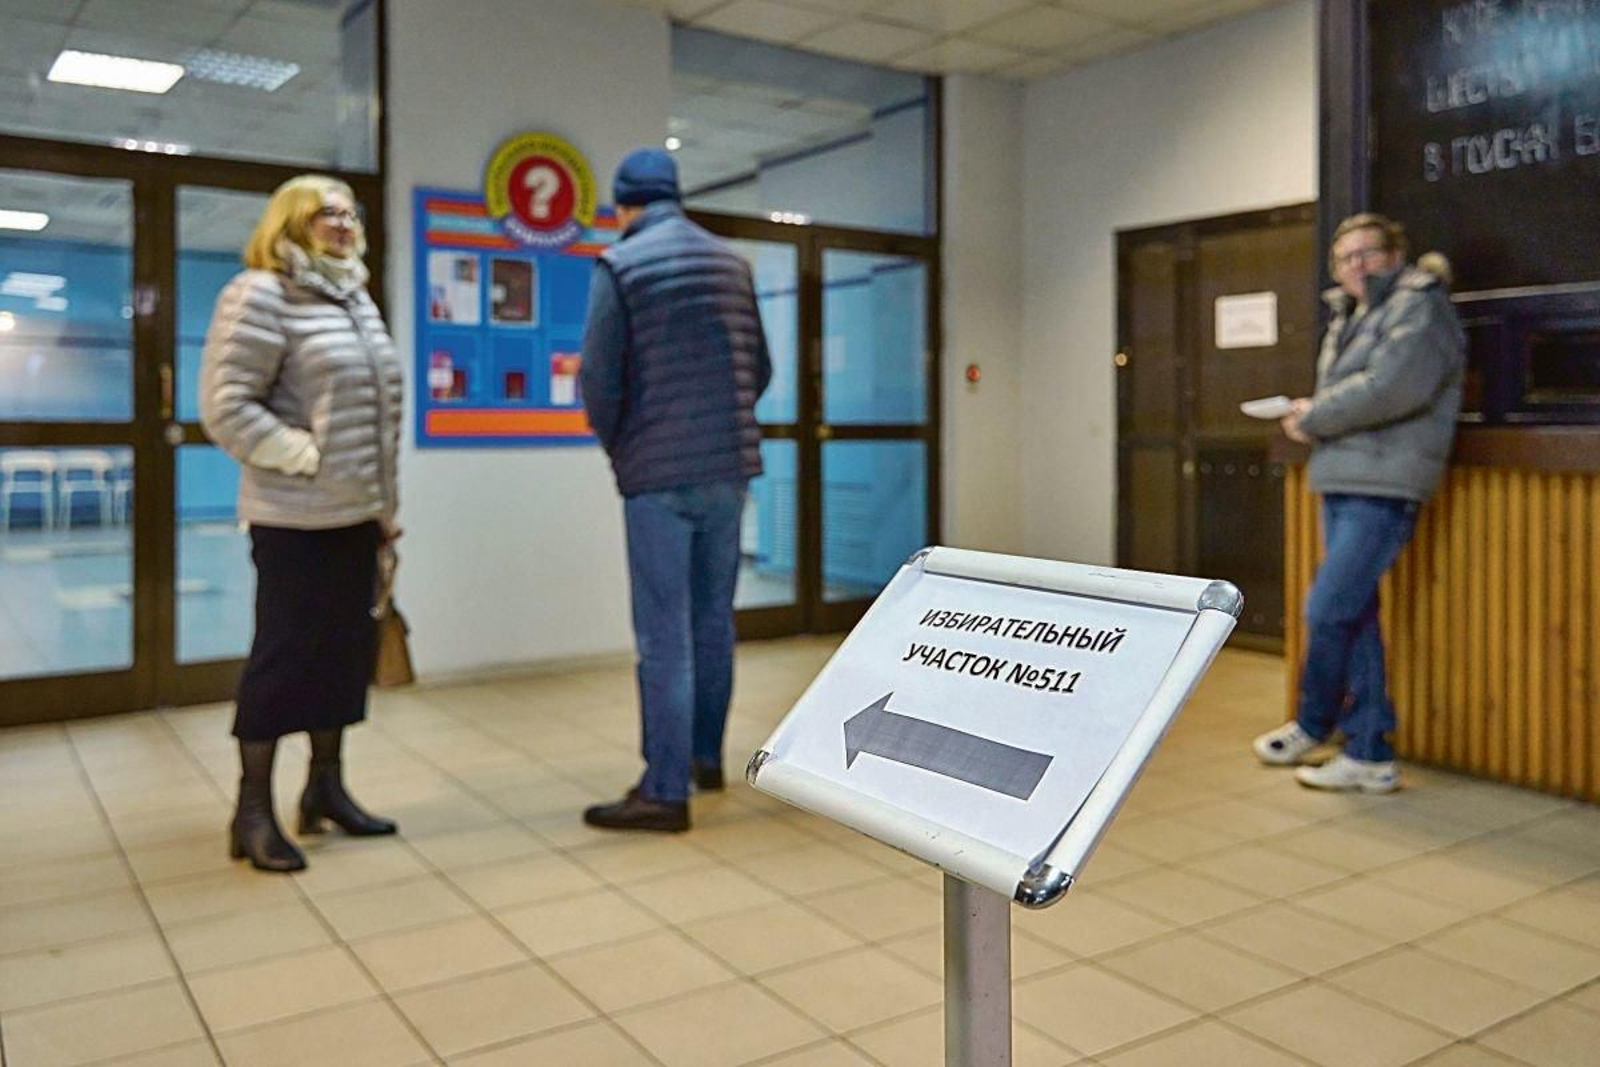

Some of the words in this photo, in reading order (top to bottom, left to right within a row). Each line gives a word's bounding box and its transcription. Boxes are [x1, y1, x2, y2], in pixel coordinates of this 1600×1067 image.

[919, 608, 1127, 653] ИЗБИРАТЕЛЬНЫЙ
[903, 643, 1007, 680] УЧАСТОК
[1005, 663, 1081, 693] №511
